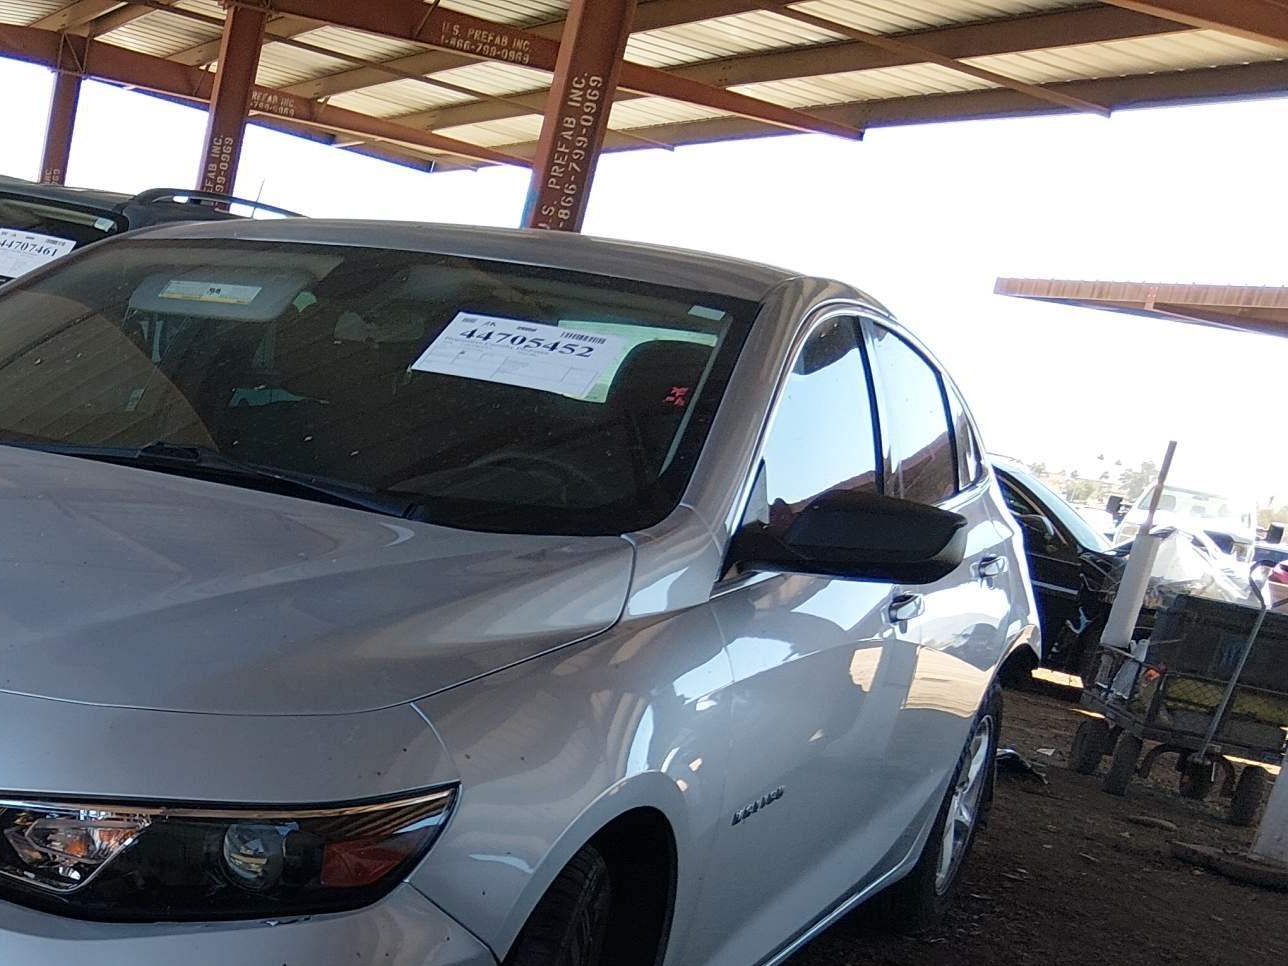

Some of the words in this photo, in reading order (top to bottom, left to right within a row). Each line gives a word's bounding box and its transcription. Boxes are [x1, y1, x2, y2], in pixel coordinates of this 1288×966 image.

[468, 30, 508, 46] PREFAB
[547, 117, 576, 189] PREFAB
[568, 72, 588, 108] INC.
[558, 75, 603, 228] -866-799-0969
[460, 328, 594, 358] 44705452
